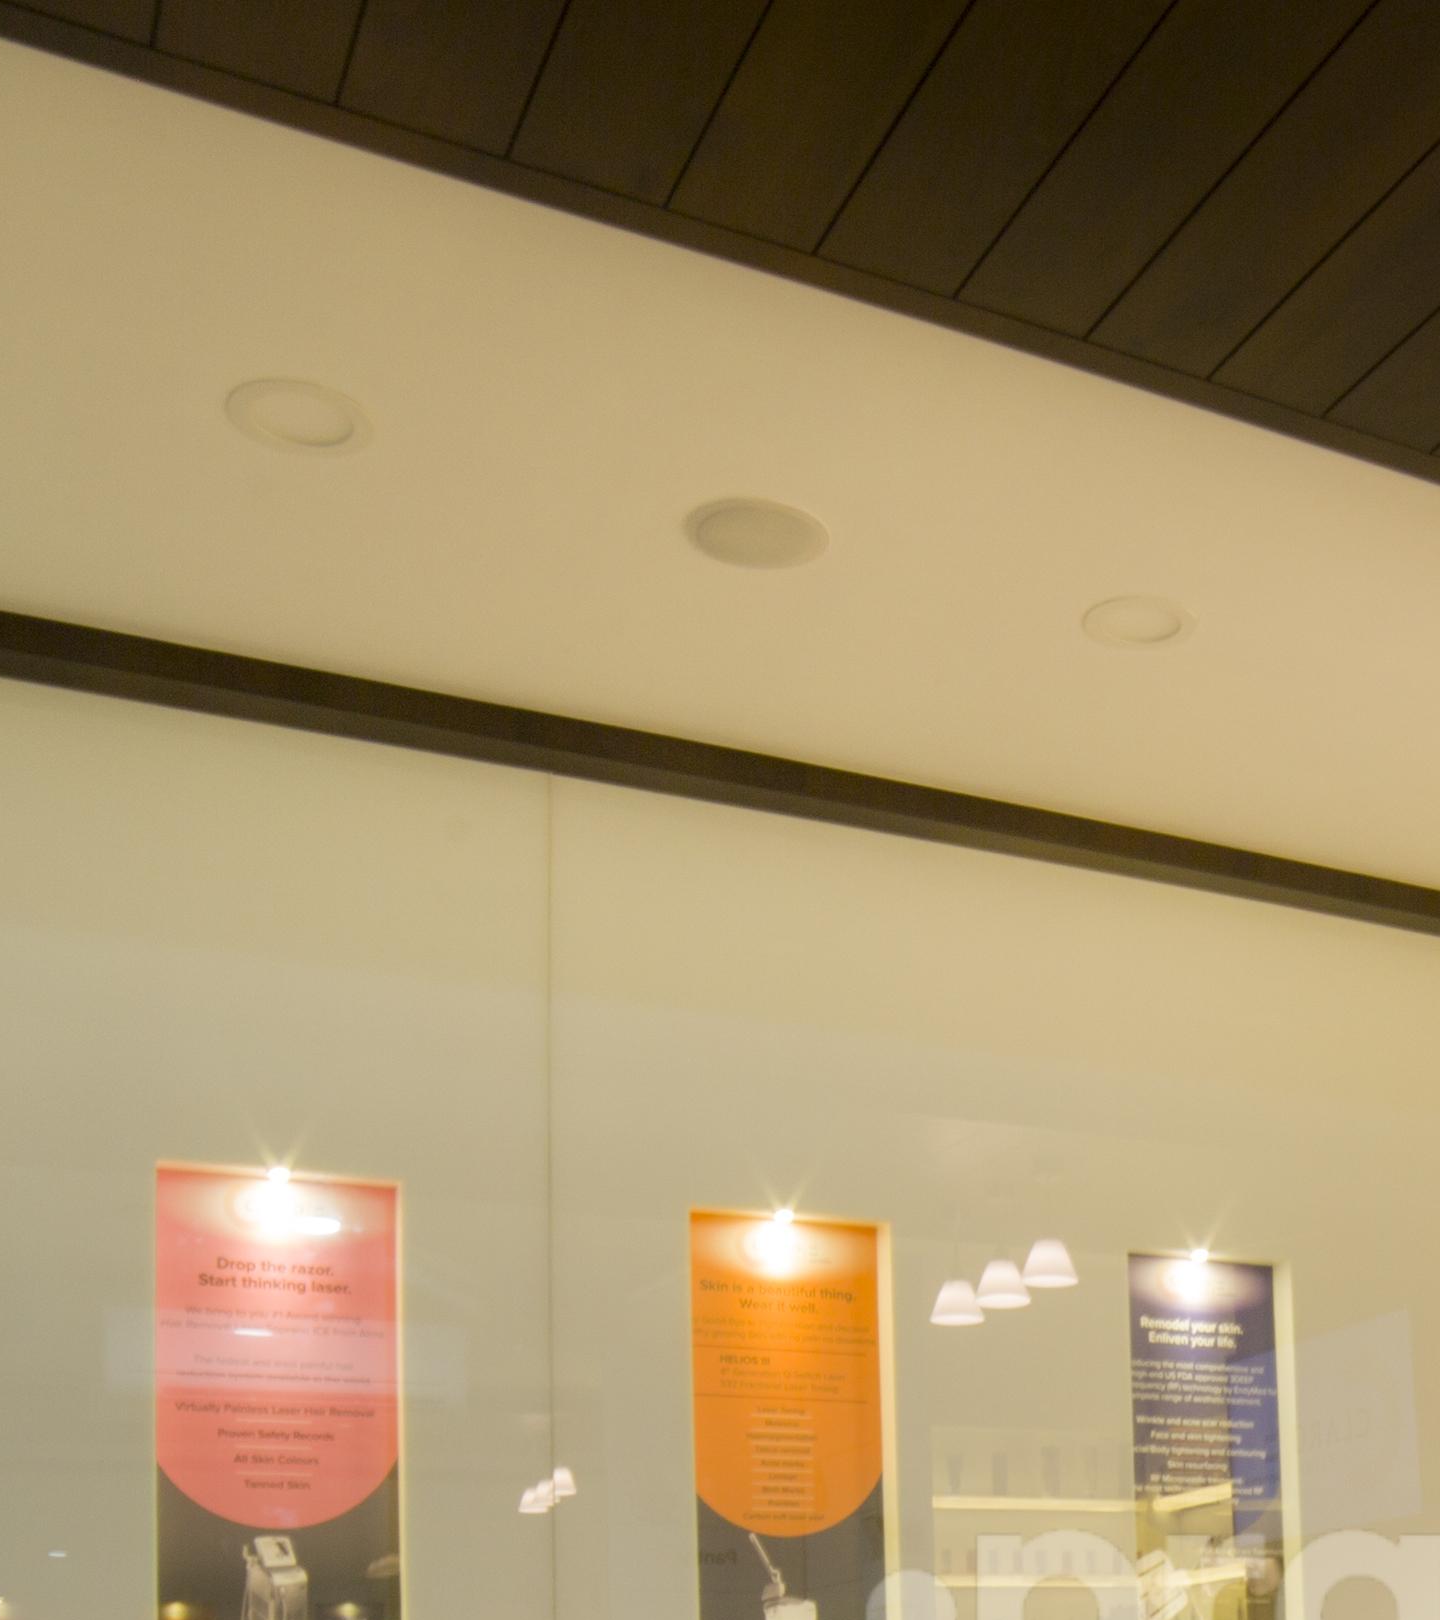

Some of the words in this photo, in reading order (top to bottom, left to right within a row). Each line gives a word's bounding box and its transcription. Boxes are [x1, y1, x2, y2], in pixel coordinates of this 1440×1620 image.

[216, 1257, 256, 1273] Drop
[260, 1260, 287, 1273] the
[291, 1264, 335, 1278] razor.
[197, 1273, 237, 1288] Start
[241, 1275, 306, 1295] thinking
[310, 1280, 352, 1295] laser.
[699, 1279, 729, 1294] Skin
[732, 1282, 743, 1294] is
[759, 1284, 817, 1299] beautiful
[819, 1287, 857, 1305] thing.
[738, 1297, 773, 1313] Wear
[776, 1301, 786, 1313] it
[1139, 1314, 1190, 1330] Remodel
[1191, 1320, 1217, 1336] your
[1218, 1322, 1244, 1336] skin.
[1148, 1331, 1189, 1345] Enliven
[1190, 1335, 1216, 1349] your
[719, 1353, 759, 1367] HELIOS
[271, 1405, 302, 1417] Laser
[303, 1406, 327, 1417] Hair
[328, 1407, 376, 1418] Removal
[216, 1428, 256, 1440] Proven
[292, 1431, 336, 1442] Records
[250, 1454, 275, 1465] Skin
